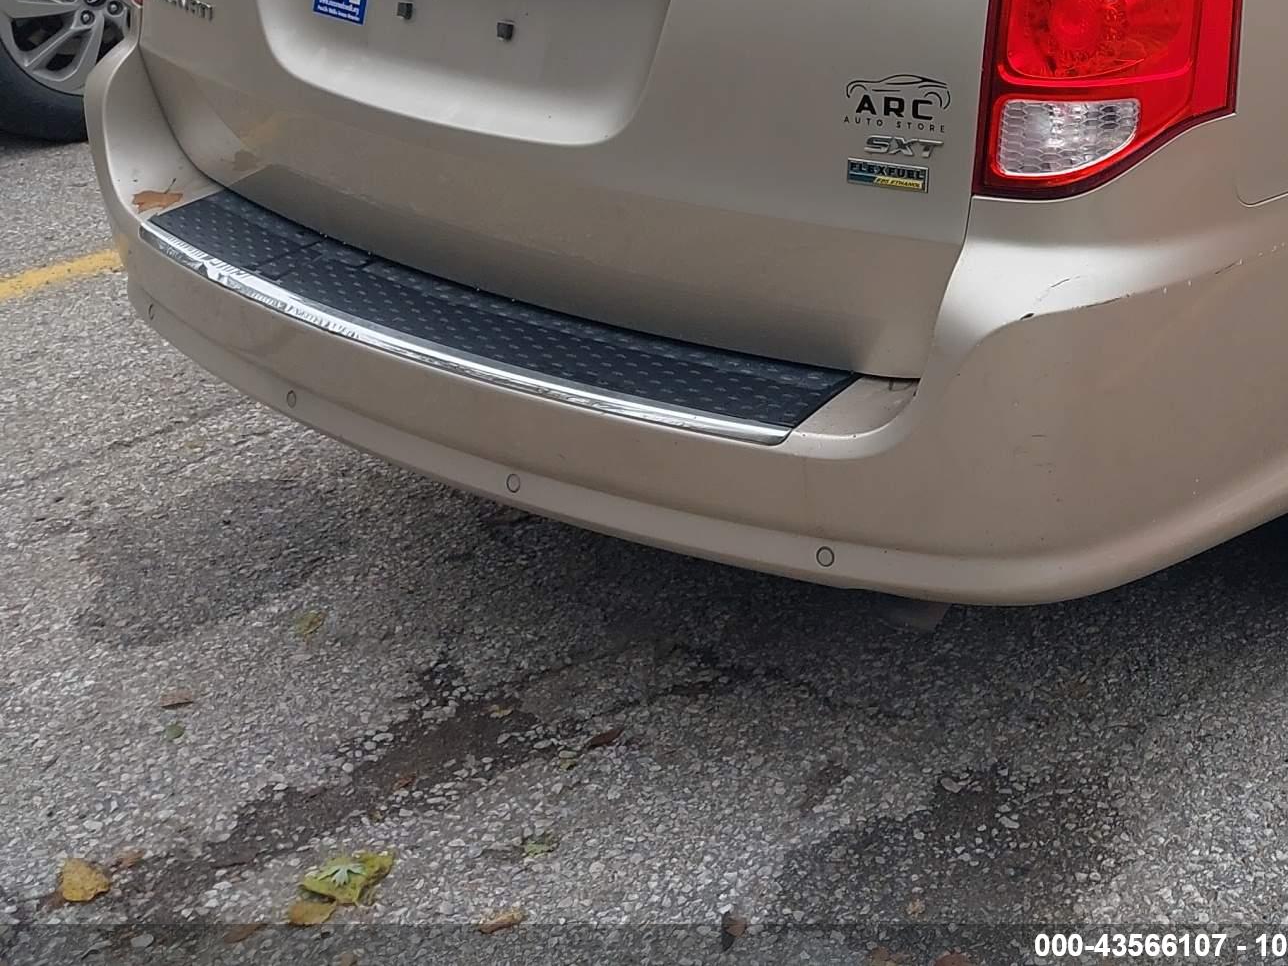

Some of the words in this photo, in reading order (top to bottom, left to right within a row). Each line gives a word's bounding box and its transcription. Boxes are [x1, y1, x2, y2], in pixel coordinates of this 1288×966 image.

[855, 94, 933, 121] ARC
[843, 115, 883, 127] AUTO
[896, 121, 945, 133] STORE
[864, 135, 943, 158] SXT
